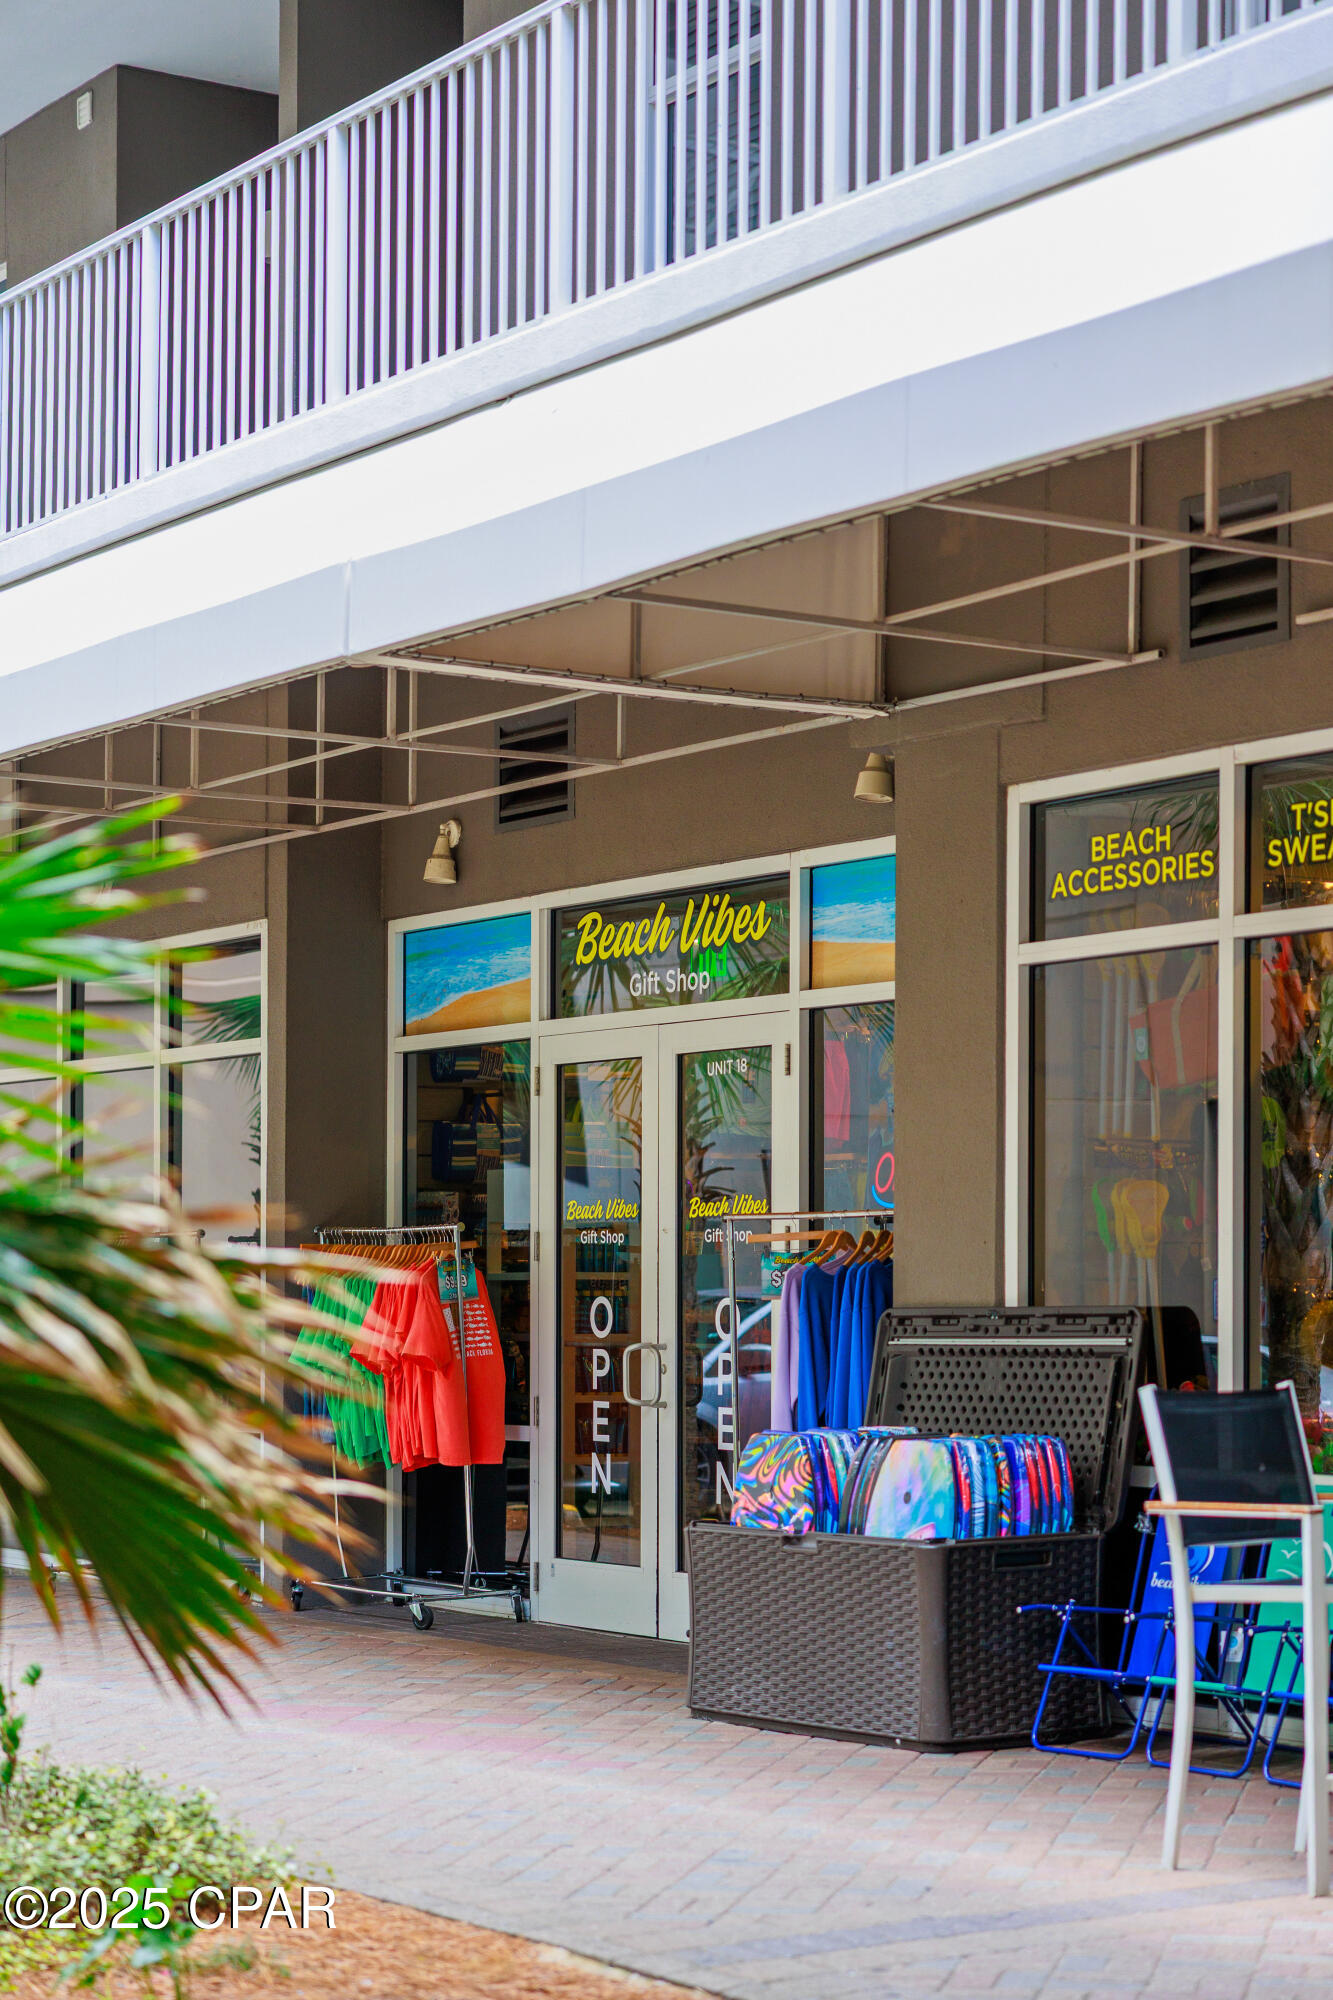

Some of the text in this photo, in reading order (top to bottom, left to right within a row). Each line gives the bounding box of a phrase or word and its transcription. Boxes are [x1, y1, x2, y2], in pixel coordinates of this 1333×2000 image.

[1290, 798, 1333, 831] T'S
[1091, 824, 1171, 863] BEACH
[1051, 850, 1215, 899] ACCESSORIES
[575, 893, 772, 966] Beach Vibes
[629, 966, 711, 997] Gift Shop
[707, 1057, 748, 1077] UNIT 18
[875, 1152, 894, 1193] O
[567, 1197, 639, 1220] Beach Vibes
[688, 1193, 769, 1218] Beach Vibes
[580, 1229, 625, 1246] Gift Shop
[704, 1227, 723, 1243] Gift
[589, 1295, 613, 1495] OPEN
